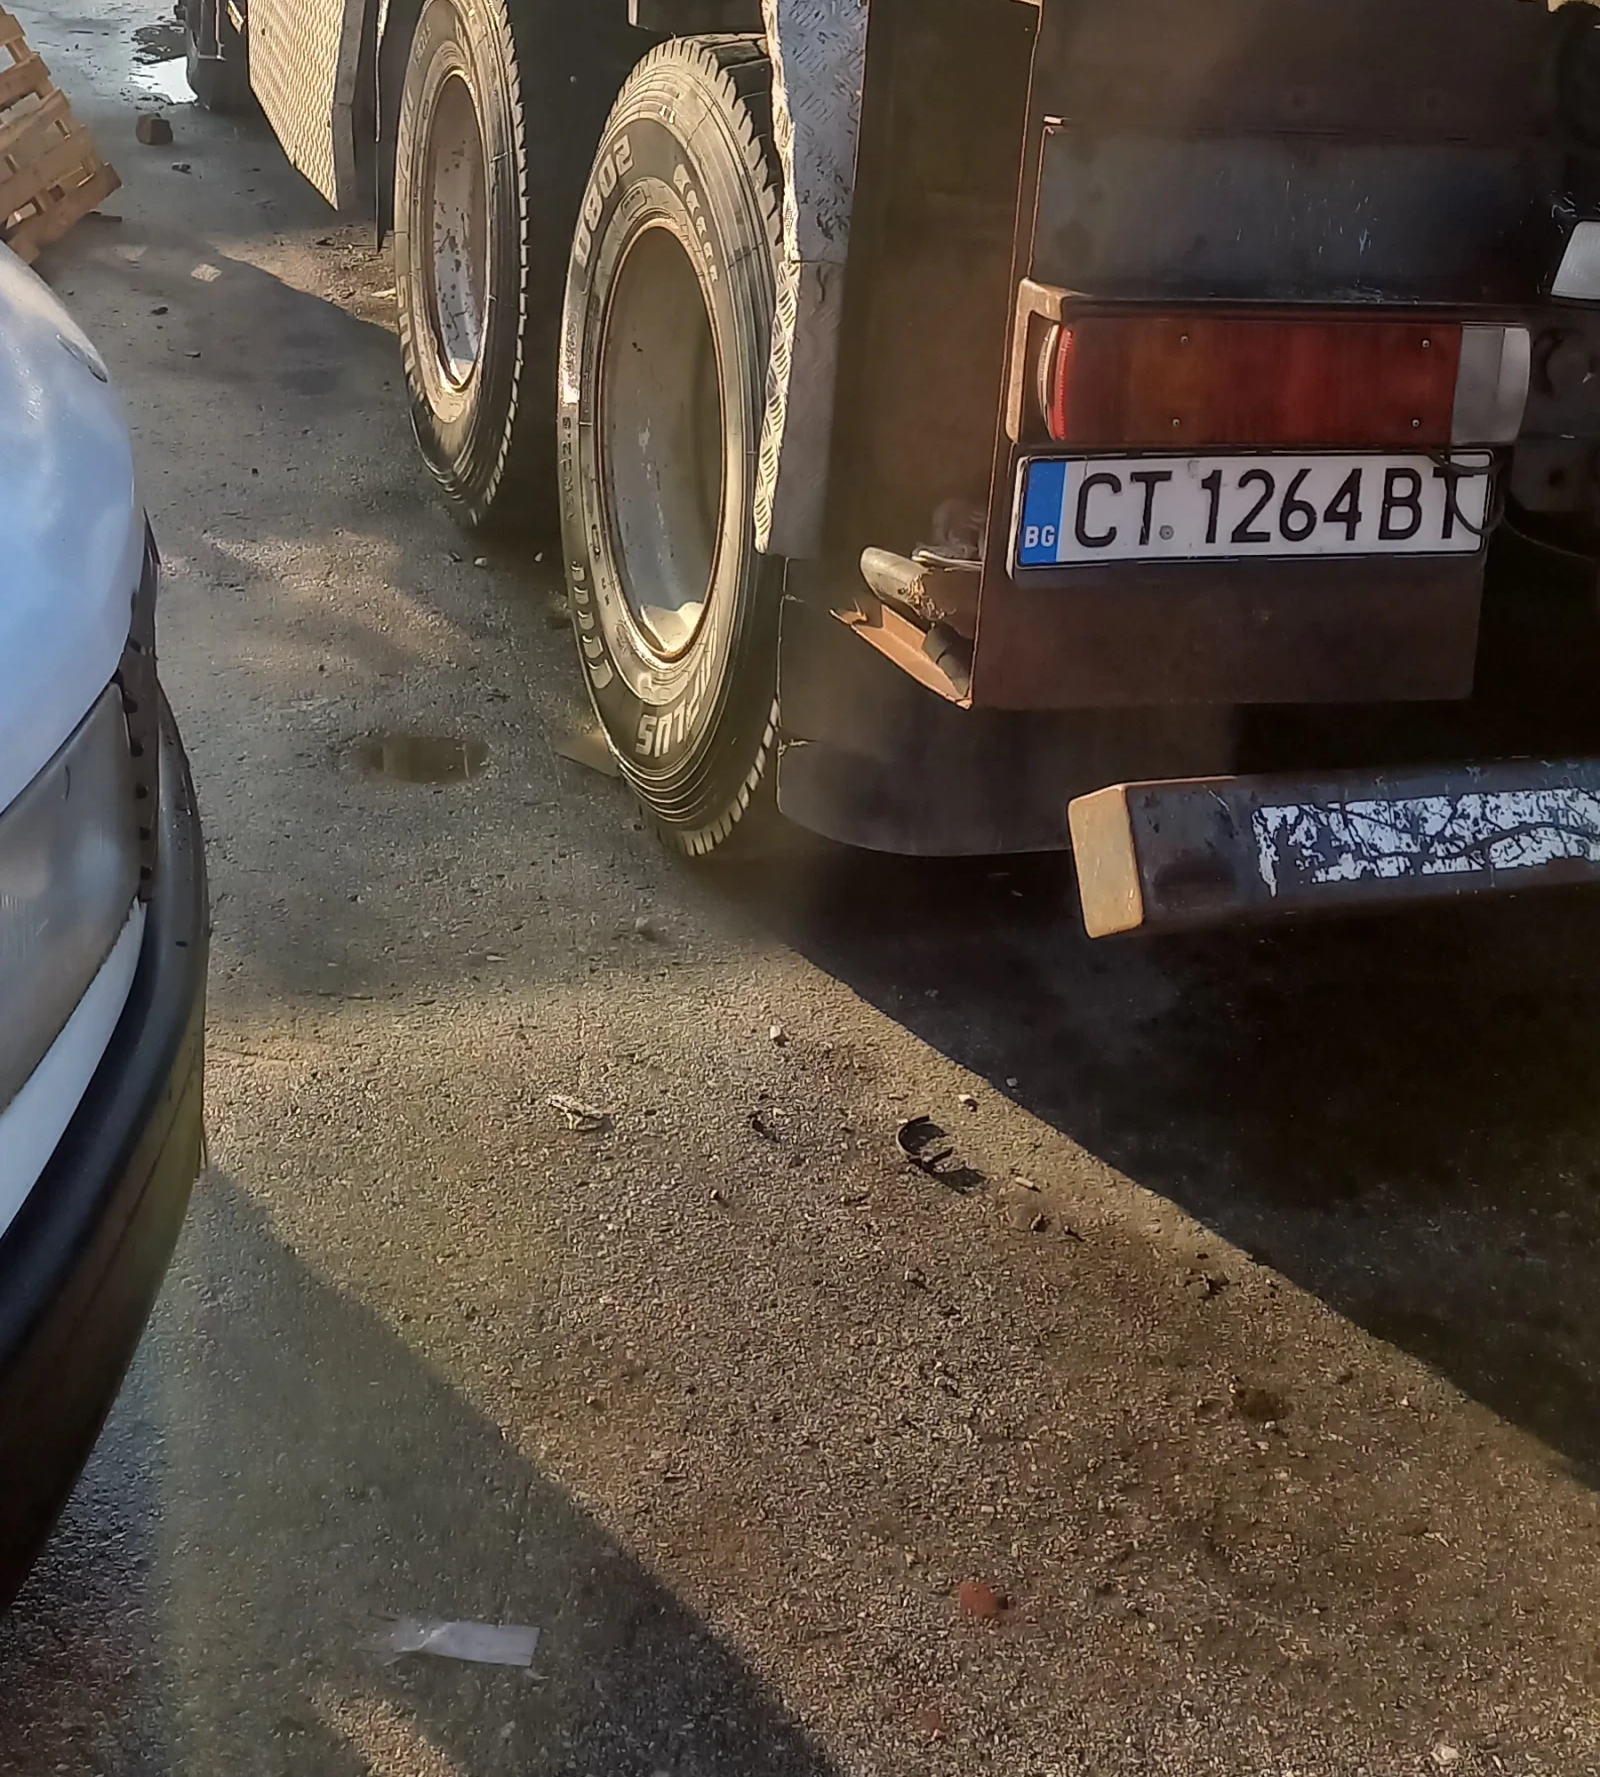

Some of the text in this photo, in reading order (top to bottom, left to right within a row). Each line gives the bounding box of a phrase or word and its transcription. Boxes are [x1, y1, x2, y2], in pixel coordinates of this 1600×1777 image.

[1074, 471, 1173, 549] CT
[1201, 467, 1362, 544] 1264
[1024, 525, 1056, 549] BG
